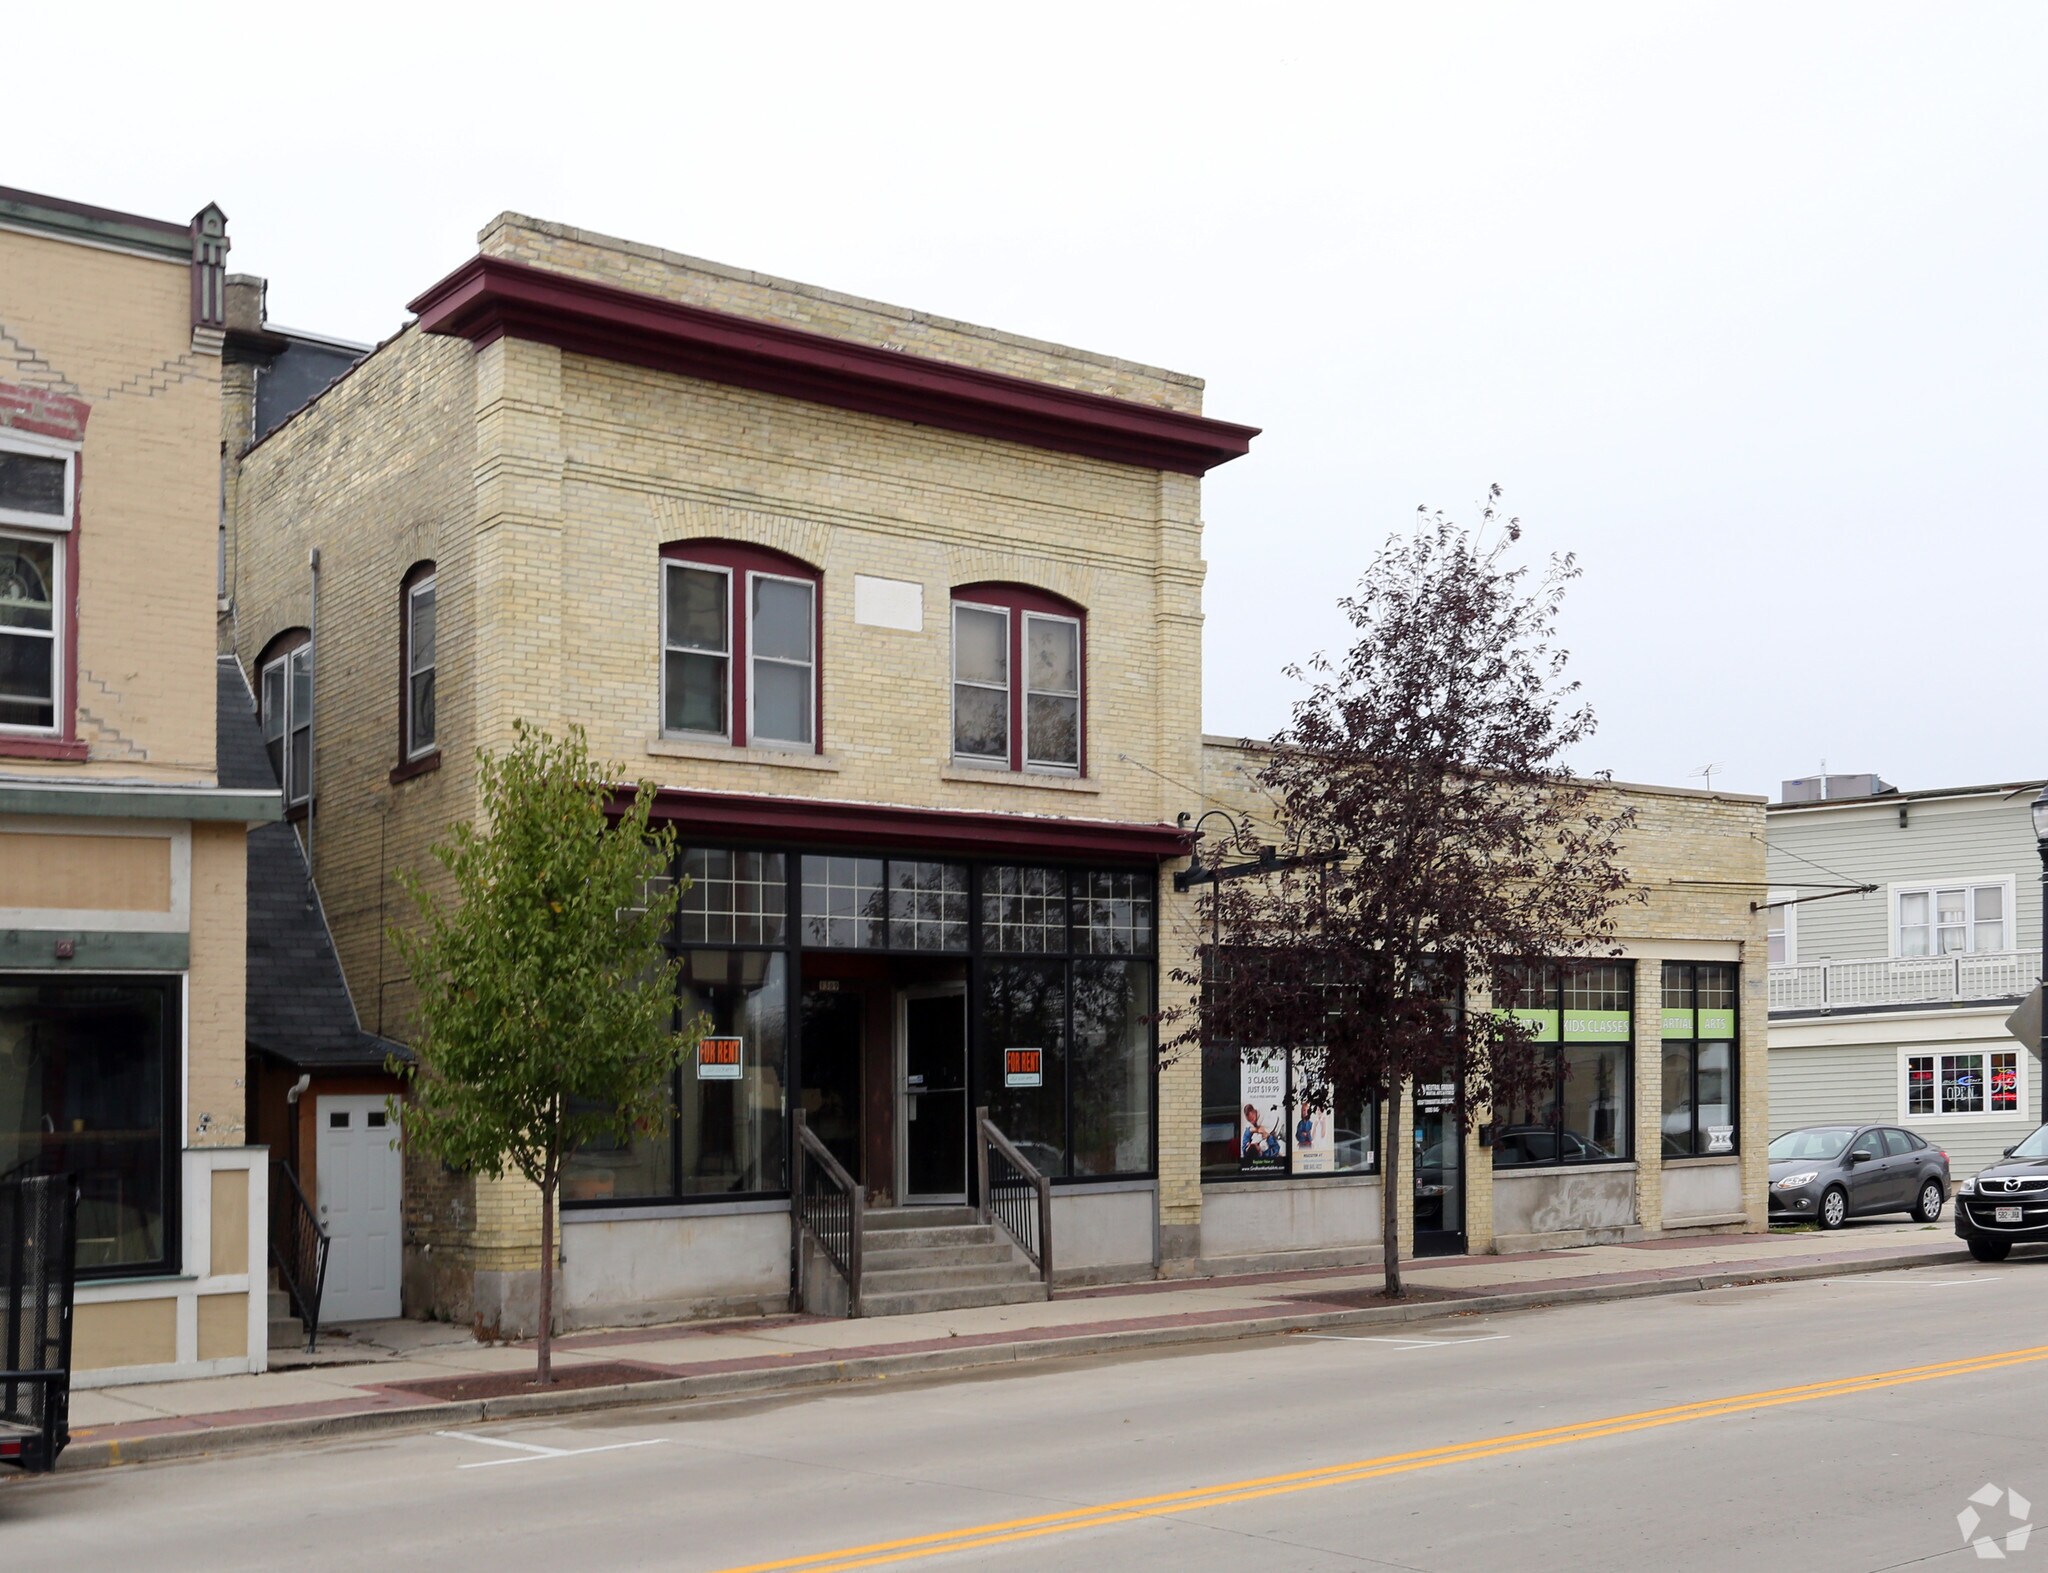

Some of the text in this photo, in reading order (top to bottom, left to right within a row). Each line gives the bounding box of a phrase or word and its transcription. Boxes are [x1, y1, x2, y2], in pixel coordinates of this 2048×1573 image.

[1563, 1019, 1630, 1033] KIDS CLASSES
[1662, 1018, 1726, 1030] ARTIAL ARTS
[700, 1040, 740, 1064] FOR RENT
[1007, 1051, 1040, 1073] FOR RENT
[1248, 1076, 1279, 1084] 3 CLASSES
[1261, 1085, 1280, 1093] $19.99
[1946, 1086, 1974, 1102] OPEN
